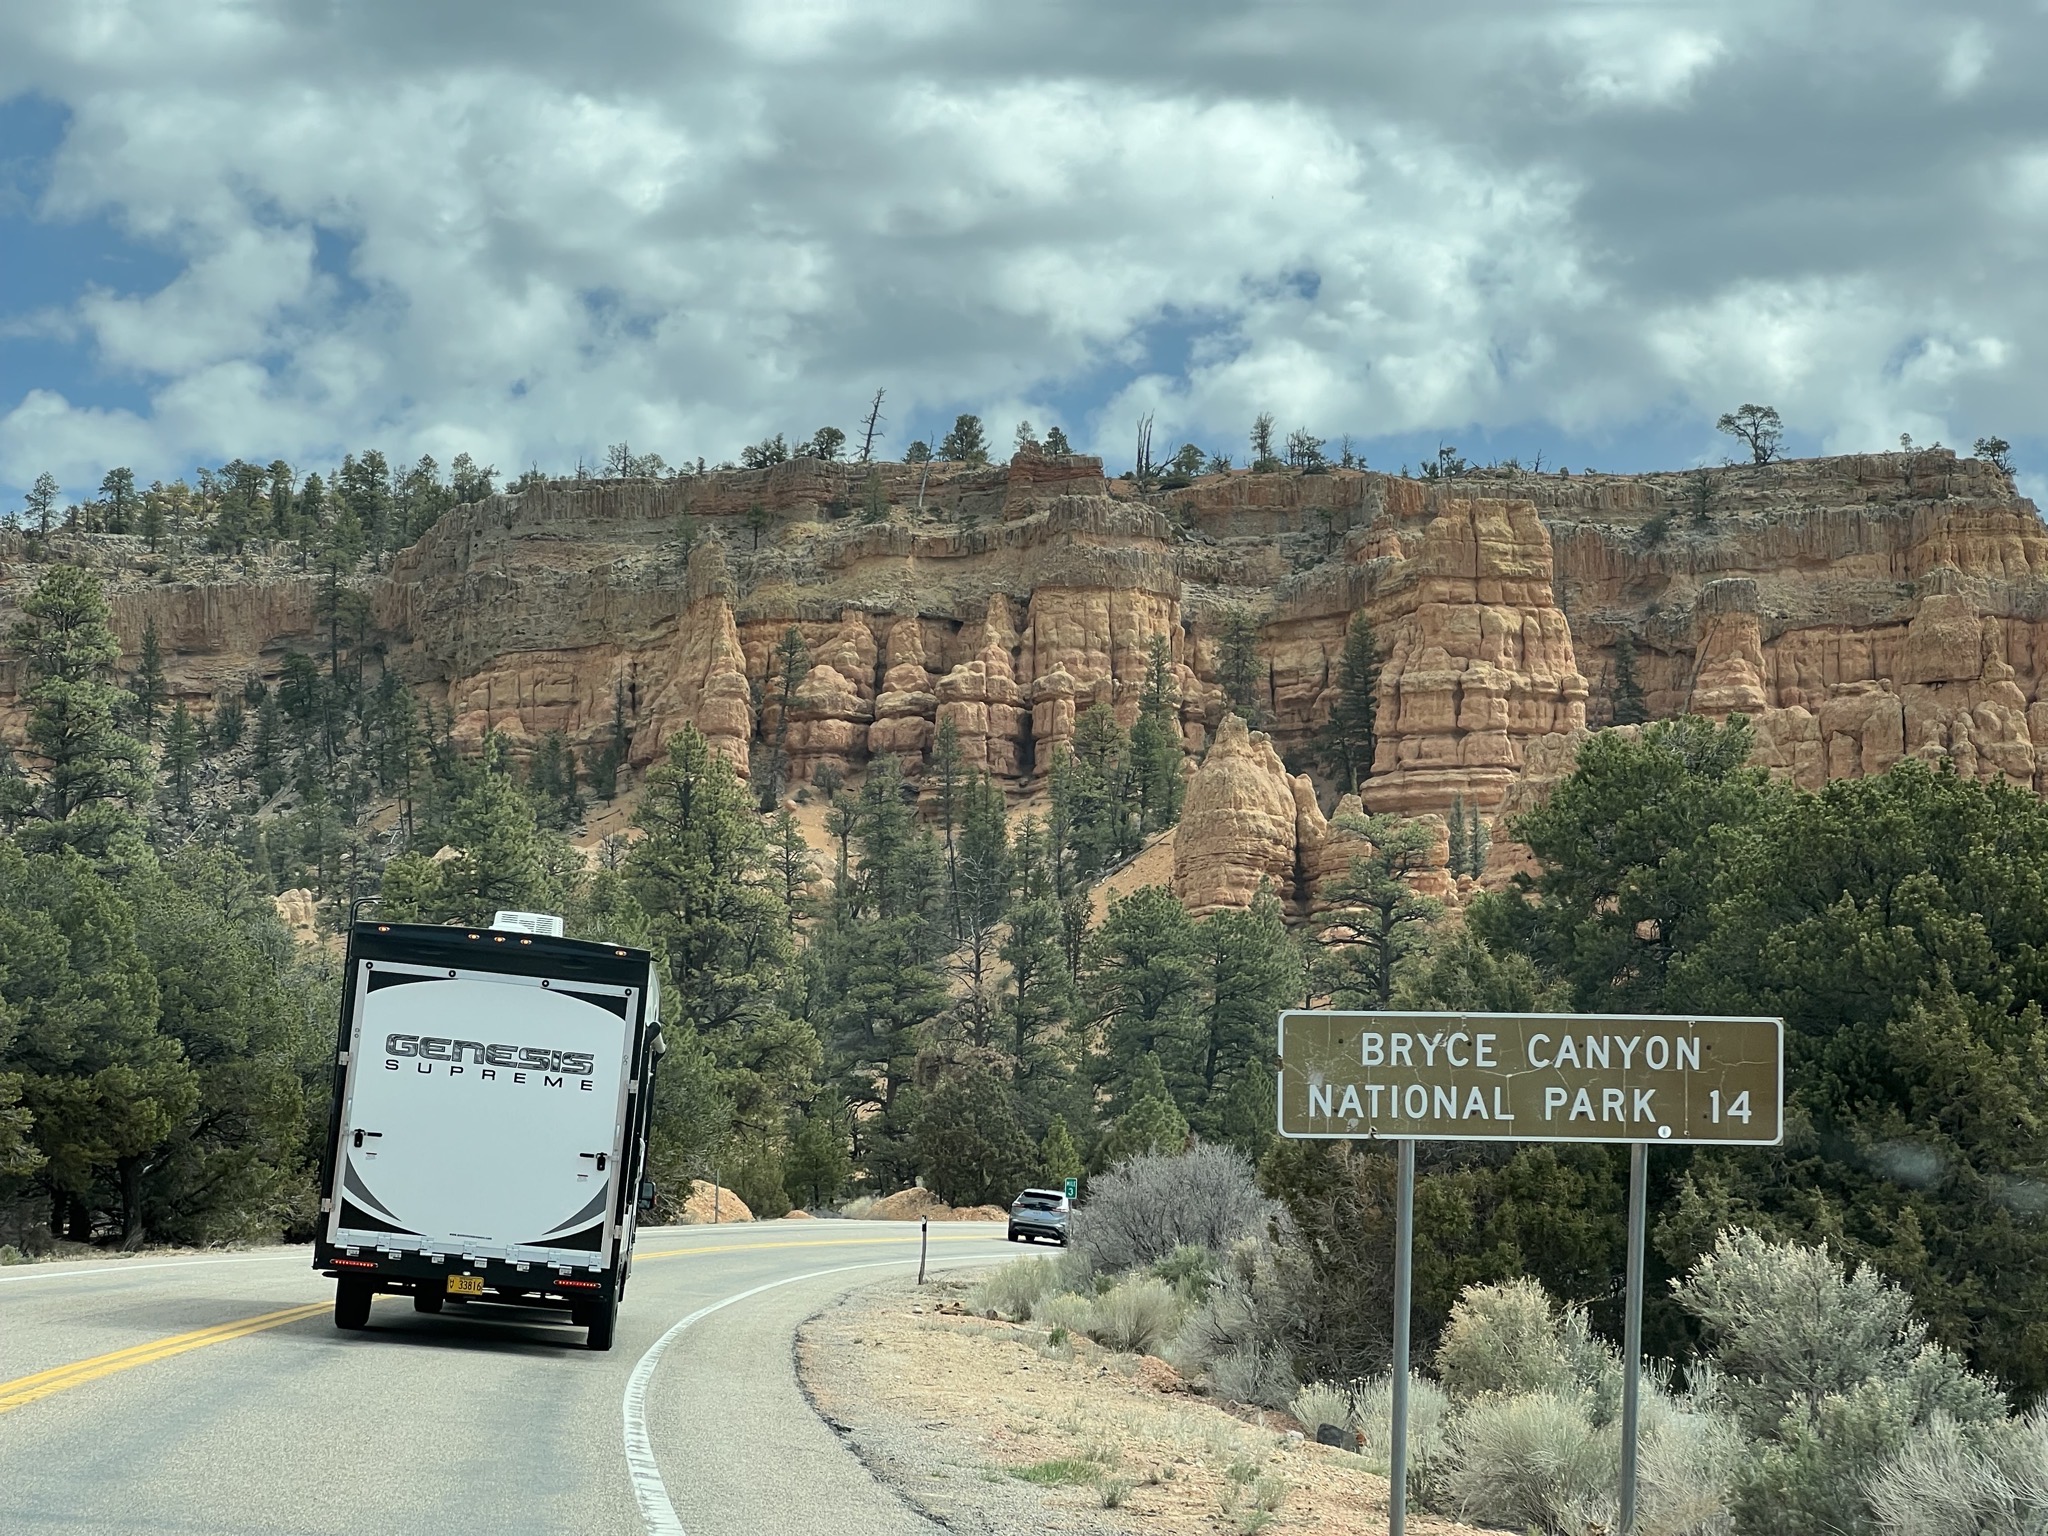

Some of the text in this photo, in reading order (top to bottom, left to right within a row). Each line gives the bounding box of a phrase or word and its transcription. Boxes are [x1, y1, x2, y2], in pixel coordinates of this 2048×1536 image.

[385, 1033, 595, 1076] GENESIS
[1361, 1032, 1701, 1071] BRYCE CANYON
[384, 1059, 594, 1092] SUPREME
[1308, 1084, 1752, 1125] NATIONAL PARK 14
[1067, 1188, 1074, 1196] 3
